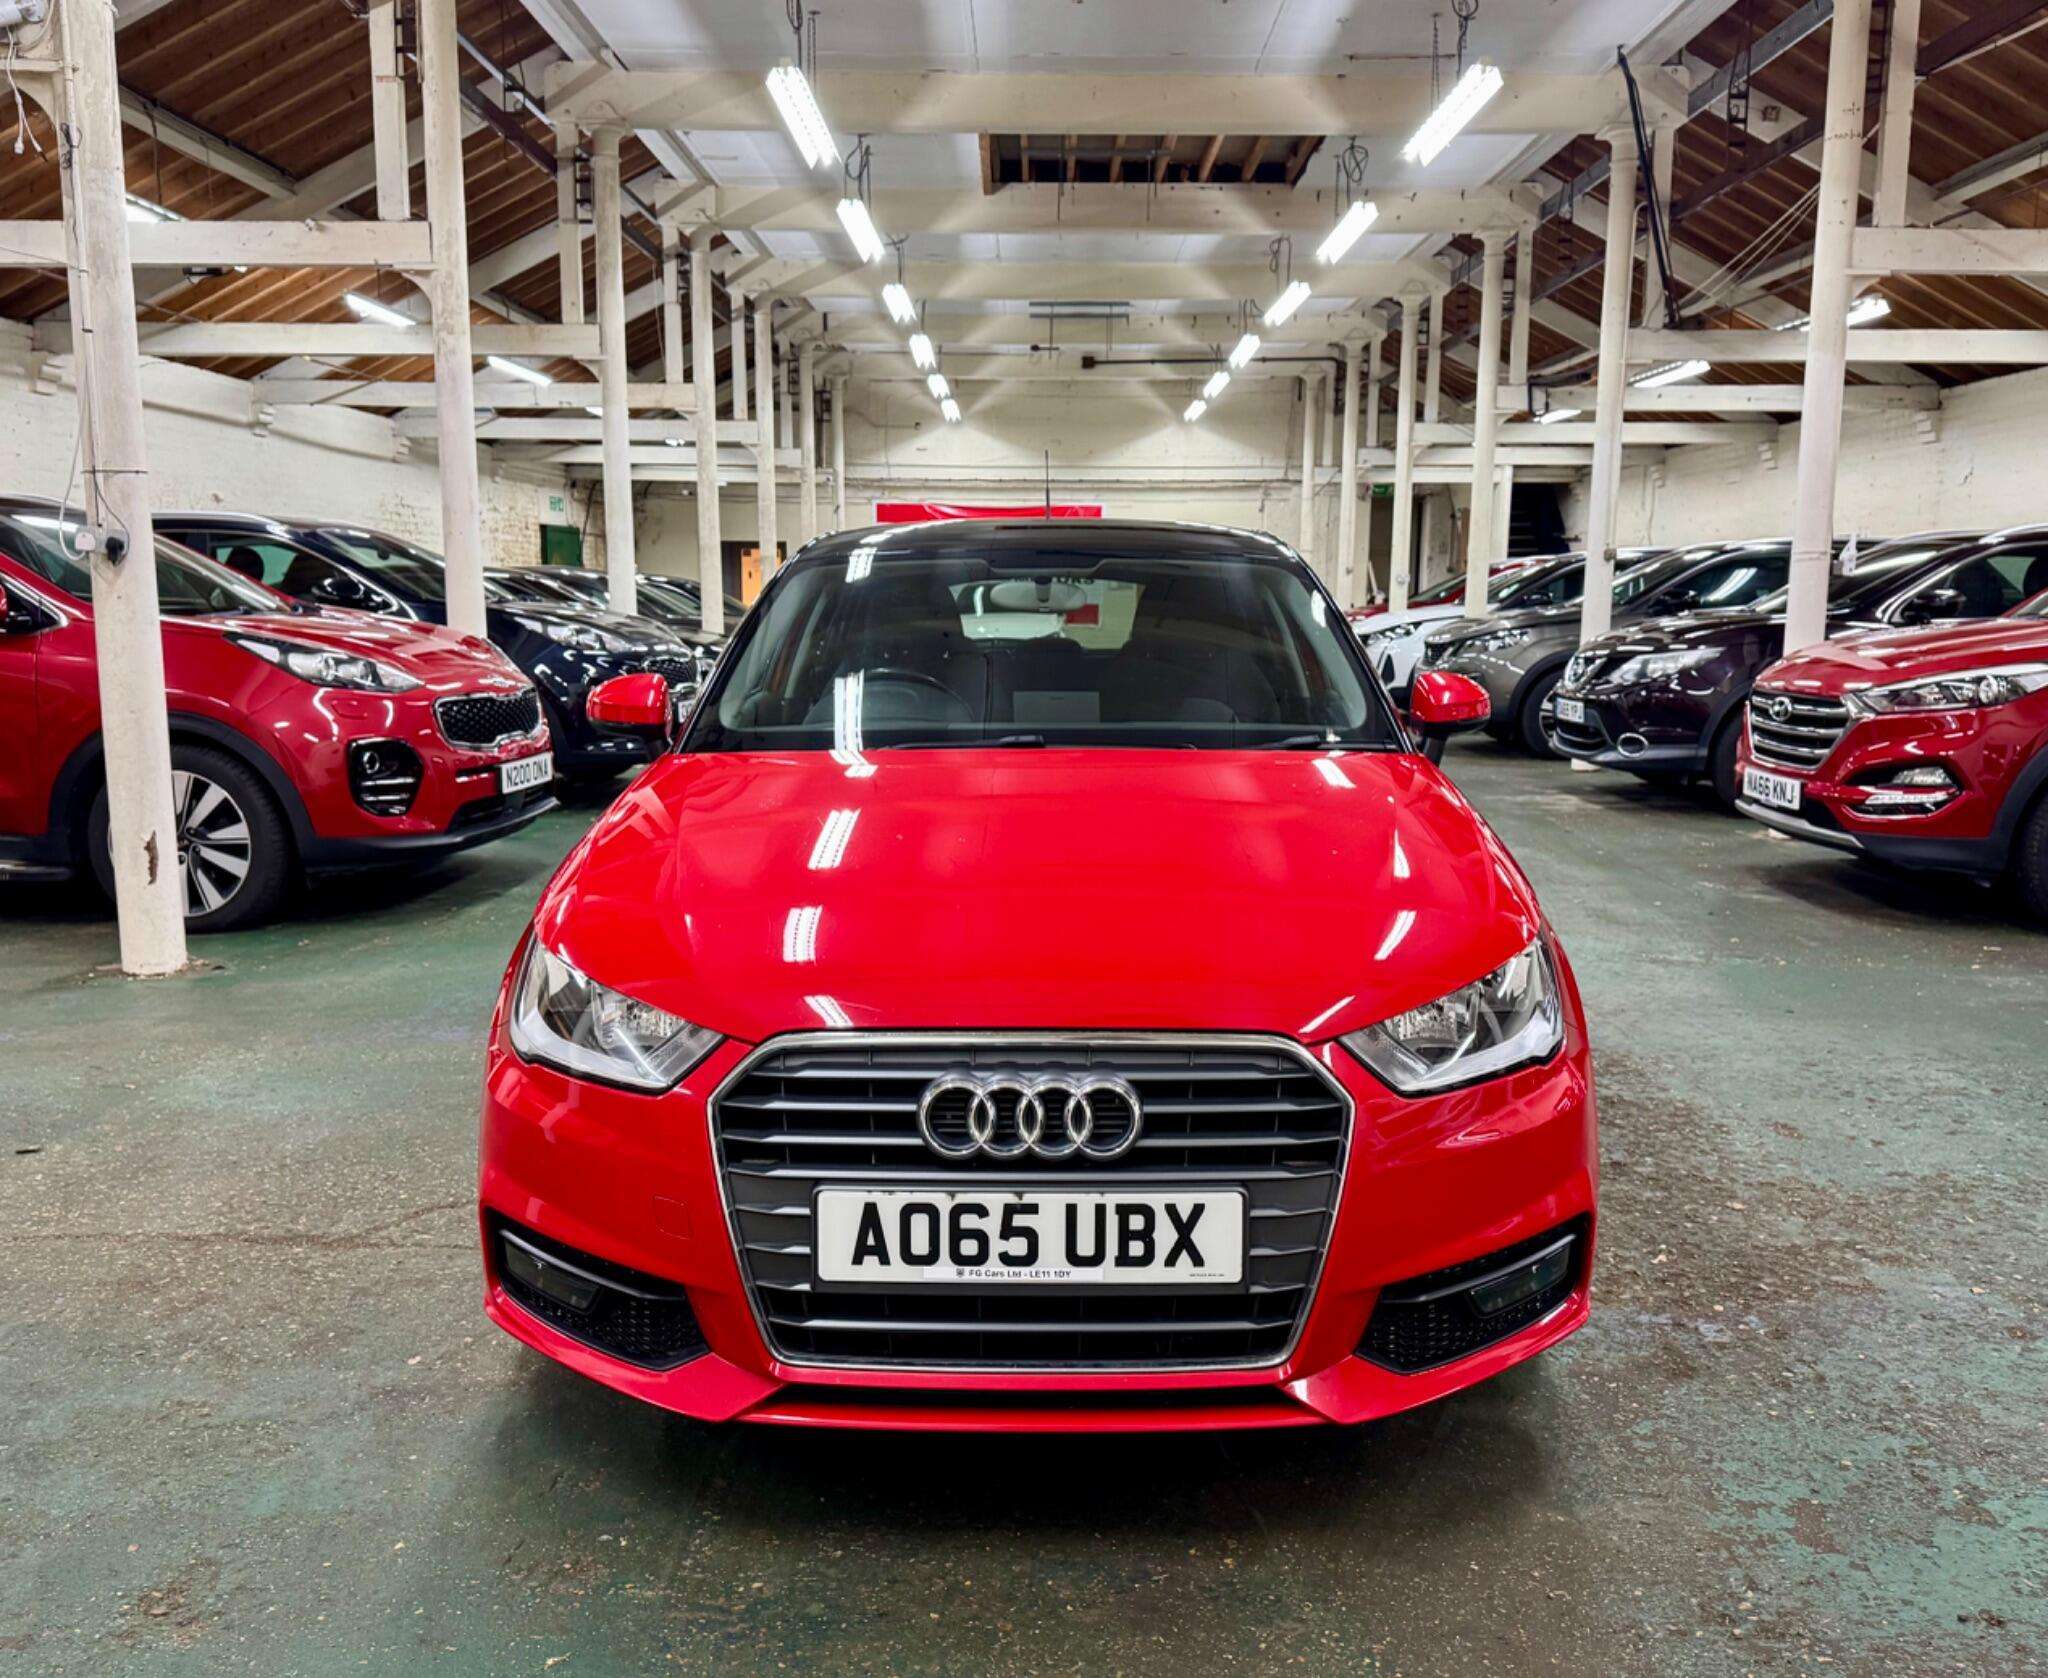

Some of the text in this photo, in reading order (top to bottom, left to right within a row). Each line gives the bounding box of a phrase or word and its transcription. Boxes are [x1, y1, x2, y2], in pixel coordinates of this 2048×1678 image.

[1772, 779, 1796, 804] KNJ
[1065, 1203, 1205, 1267] UBX
[984, 1269, 1005, 1277] Cars
[1007, 1269, 1021, 1278] Ltd
